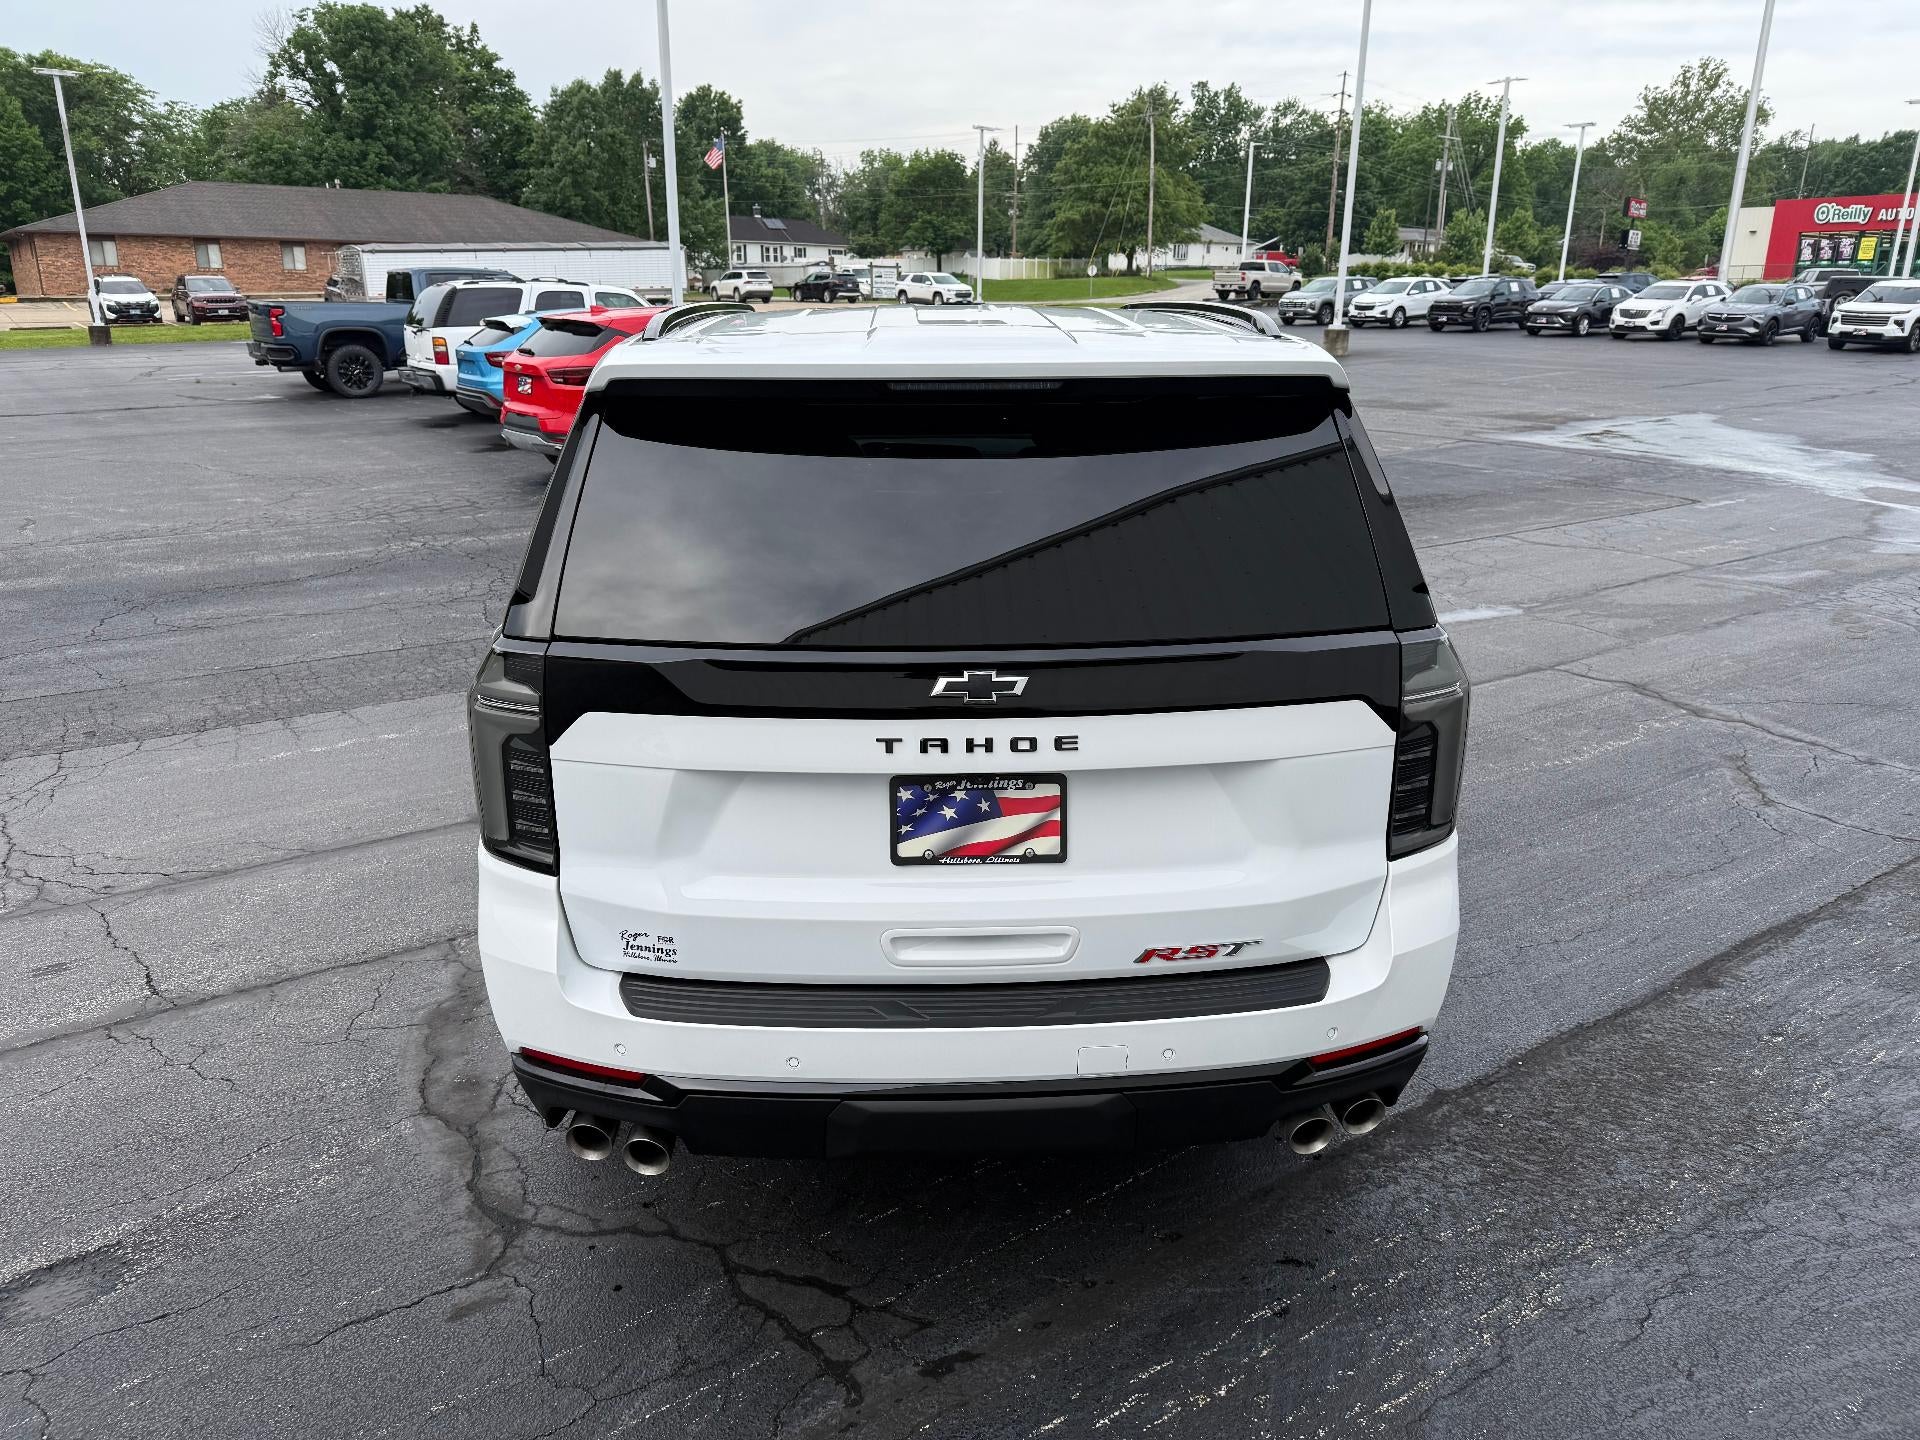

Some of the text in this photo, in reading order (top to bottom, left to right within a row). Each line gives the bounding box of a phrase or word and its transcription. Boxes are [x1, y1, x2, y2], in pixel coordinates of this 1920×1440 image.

[1814, 203, 1873, 224] O'Reilly
[875, 735, 1079, 754] TAHOE
[935, 776, 1024, 791] Roger Jenings
[619, 929, 650, 941] Roger
[622, 940, 678, 958] Jennings
[1133, 939, 1264, 964] RST
